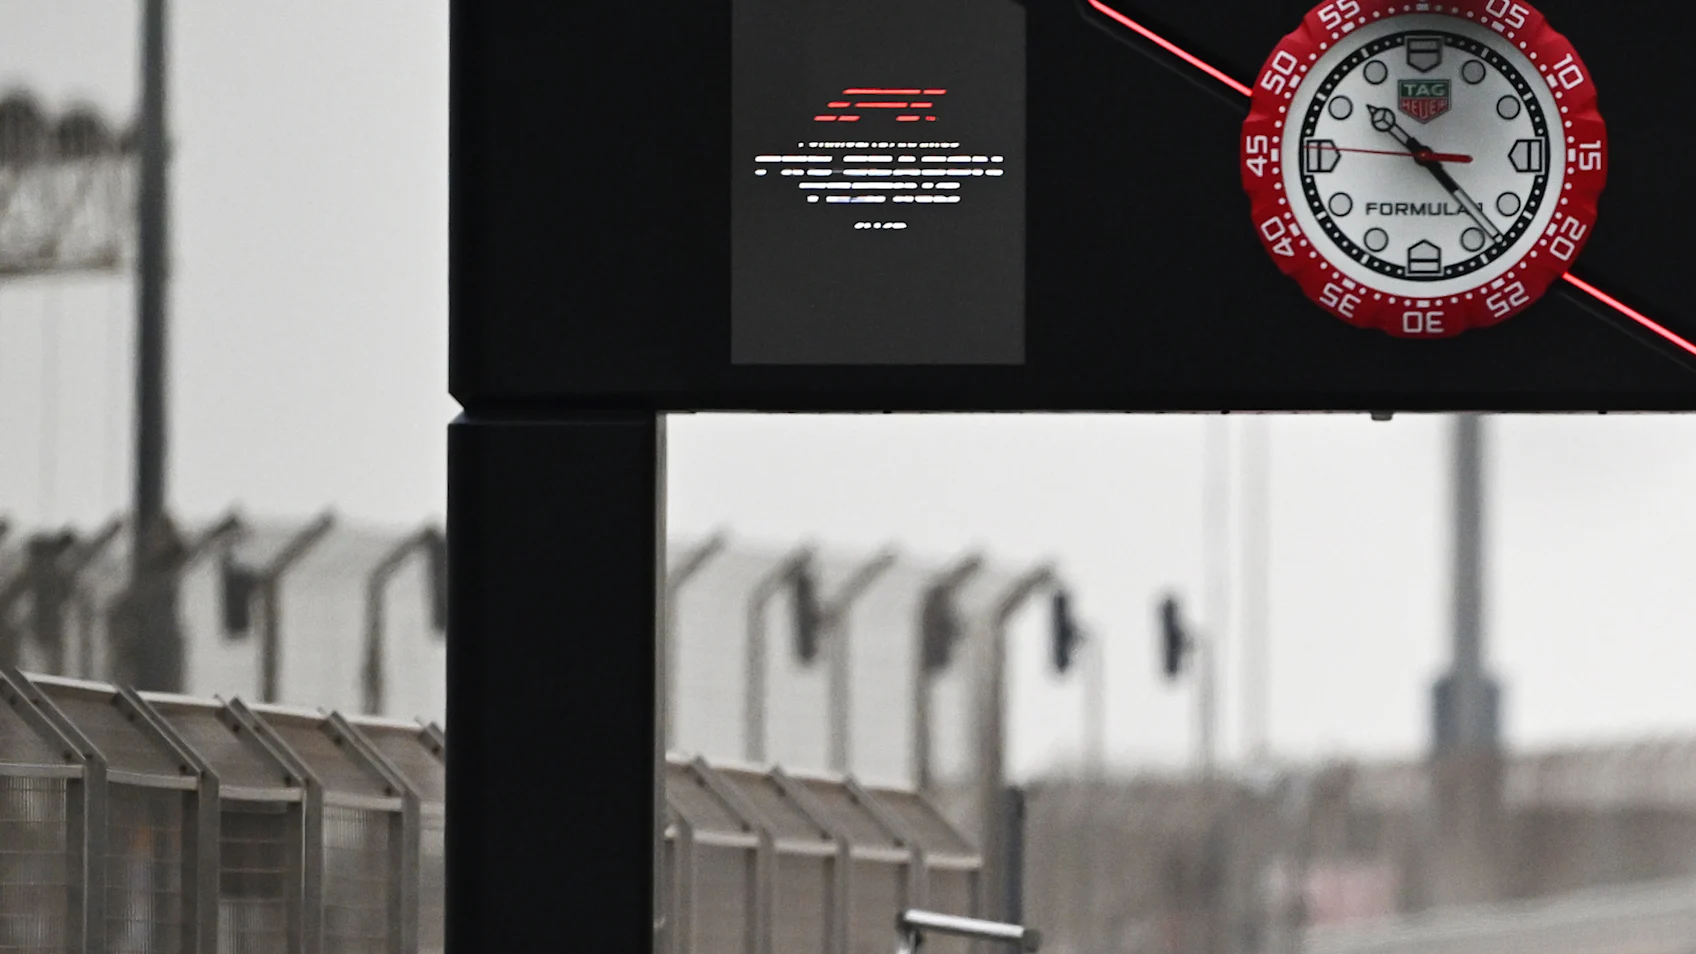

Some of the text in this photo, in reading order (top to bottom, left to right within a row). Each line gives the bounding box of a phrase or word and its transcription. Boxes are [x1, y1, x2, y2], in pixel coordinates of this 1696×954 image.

[1318, 0, 1361, 30] 55
[1486, 0, 1530, 29] 05
[1261, 50, 1298, 94] 50
[1404, 83, 1446, 96] TAG
[1552, 54, 1585, 90] 10
[1246, 135, 1268, 177] 45
[1578, 140, 1602, 171] 15
[1365, 202, 1470, 216] FORMULA
[1260, 216, 1295, 258] 40
[1549, 216, 1587, 262] 20
[1318, 283, 1362, 318] 35
[1486, 280, 1530, 318] 25
[1402, 311, 1444, 333] 30
